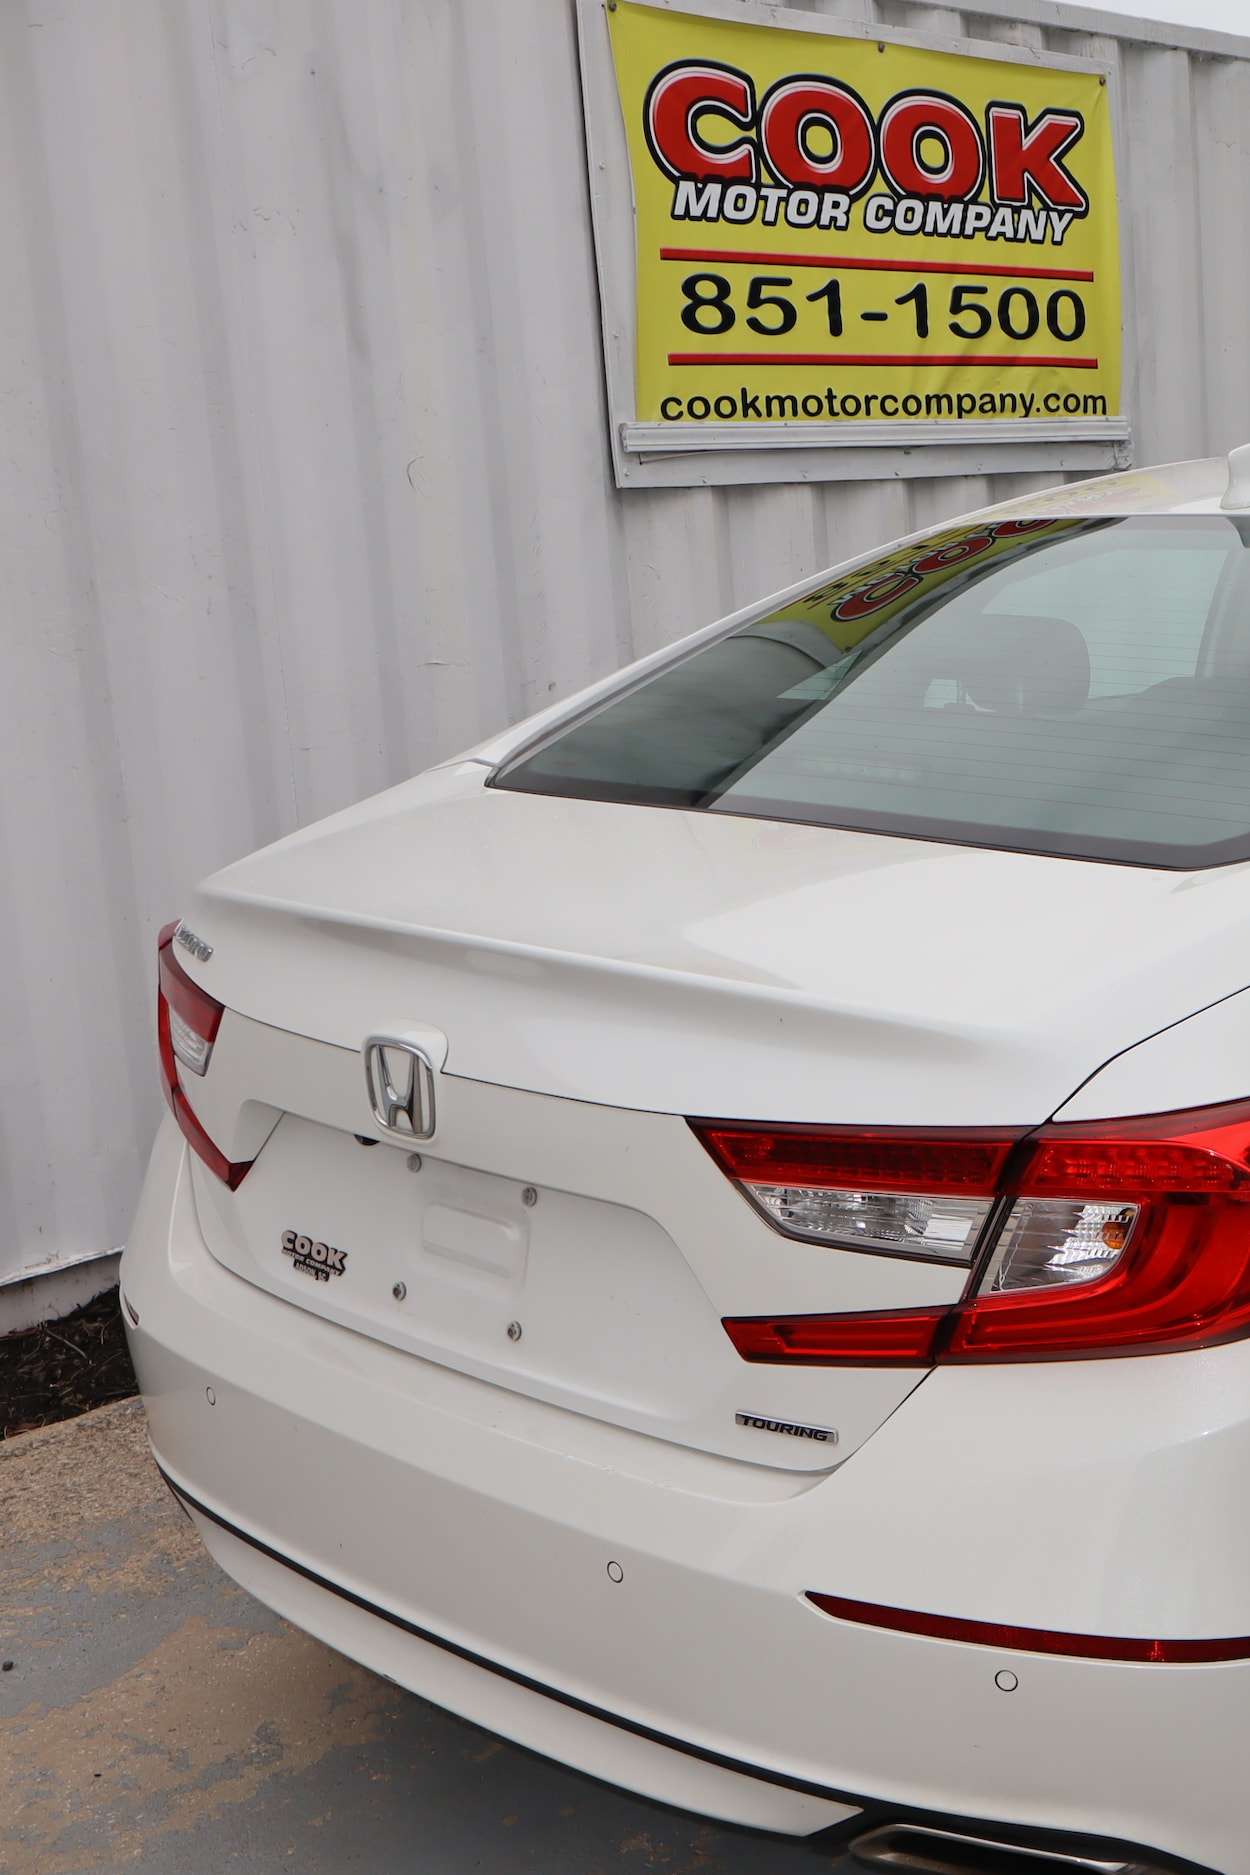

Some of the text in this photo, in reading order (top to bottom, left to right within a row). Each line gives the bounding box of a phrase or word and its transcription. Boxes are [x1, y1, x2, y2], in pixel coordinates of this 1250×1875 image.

[643, 58, 1089, 219] COOK
[672, 180, 1074, 244] MOTOR COMPANY
[681, 273, 1086, 341] 851-1500
[660, 387, 1107, 420] cookmotorcompany.com
[281, 1230, 348, 1272] COOK
[742, 1415, 829, 1441] TOURING
